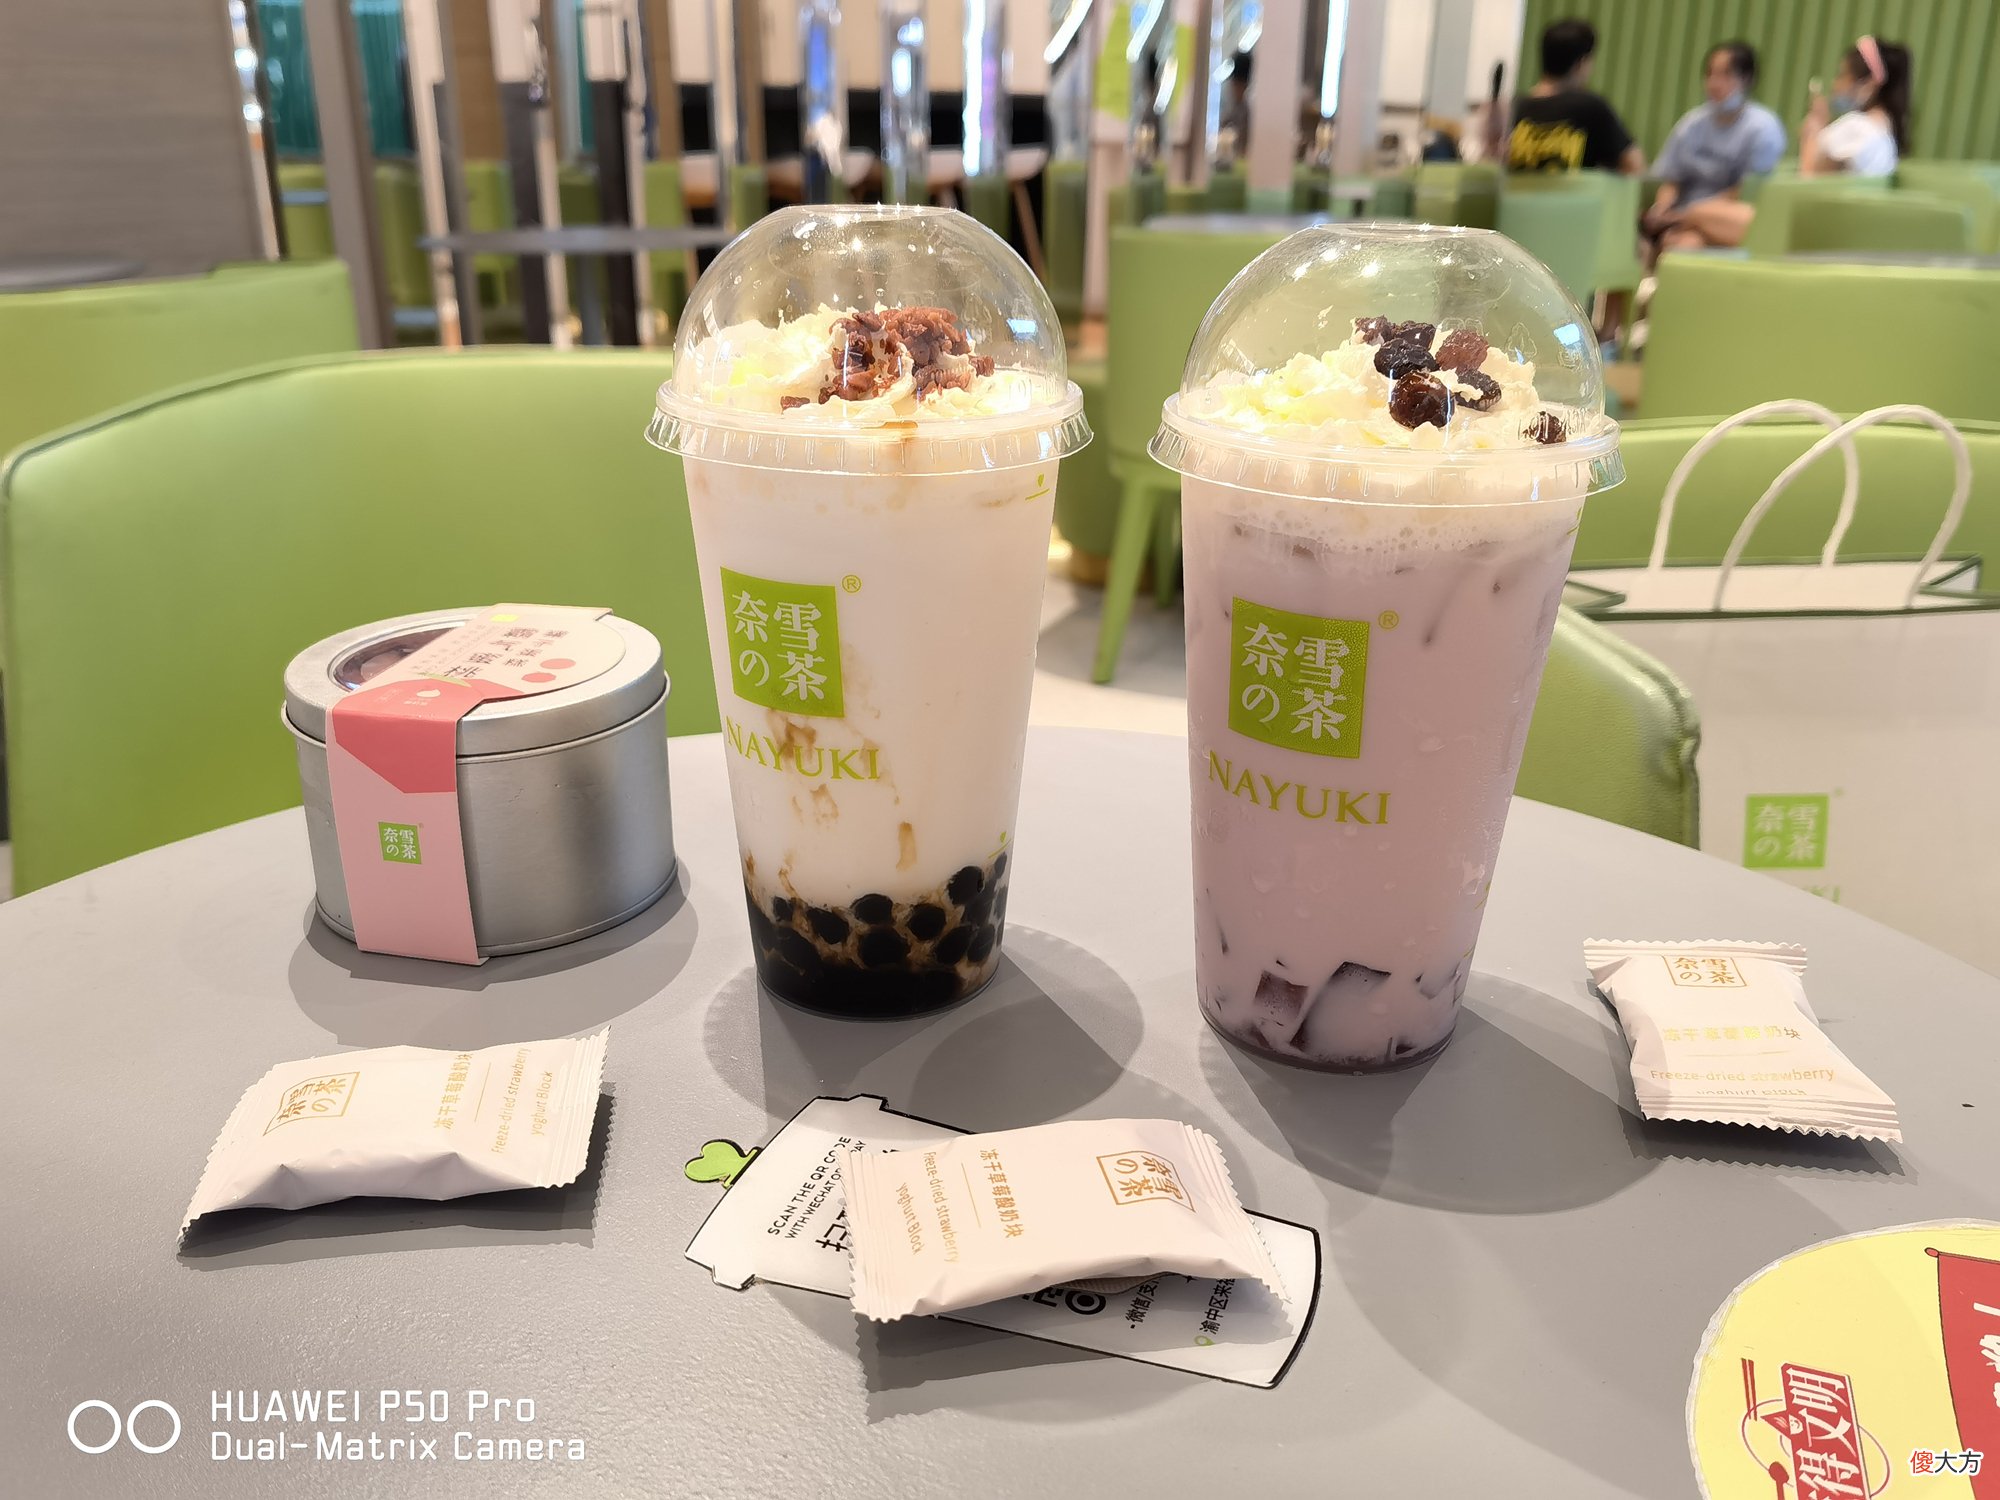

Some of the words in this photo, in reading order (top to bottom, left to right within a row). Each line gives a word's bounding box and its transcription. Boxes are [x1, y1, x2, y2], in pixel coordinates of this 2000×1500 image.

[732, 590, 822, 652] 奈雪
[1241, 622, 1350, 689] 奈雪
[725, 716, 881, 780] NAYUKI
[1208, 749, 1391, 825] NAYUKI
[507, 1047, 532, 1097] strawberry
[1650, 1069, 1745, 1082] Freeze-dried
[1751, 1067, 1835, 1082] strawberry
[530, 1101, 549, 1136] yoghurt
[767, 1204, 798, 1236] SCAN
[791, 1181, 816, 1203] THE
[810, 1165, 829, 1181] QR
[785, 1213, 810, 1239] WITH
[802, 1180, 836, 1216] WECHAT
[895, 1182, 917, 1225] yoghurt
[906, 1220, 925, 1255] Block
[935, 1203, 960, 1263] strawberry
